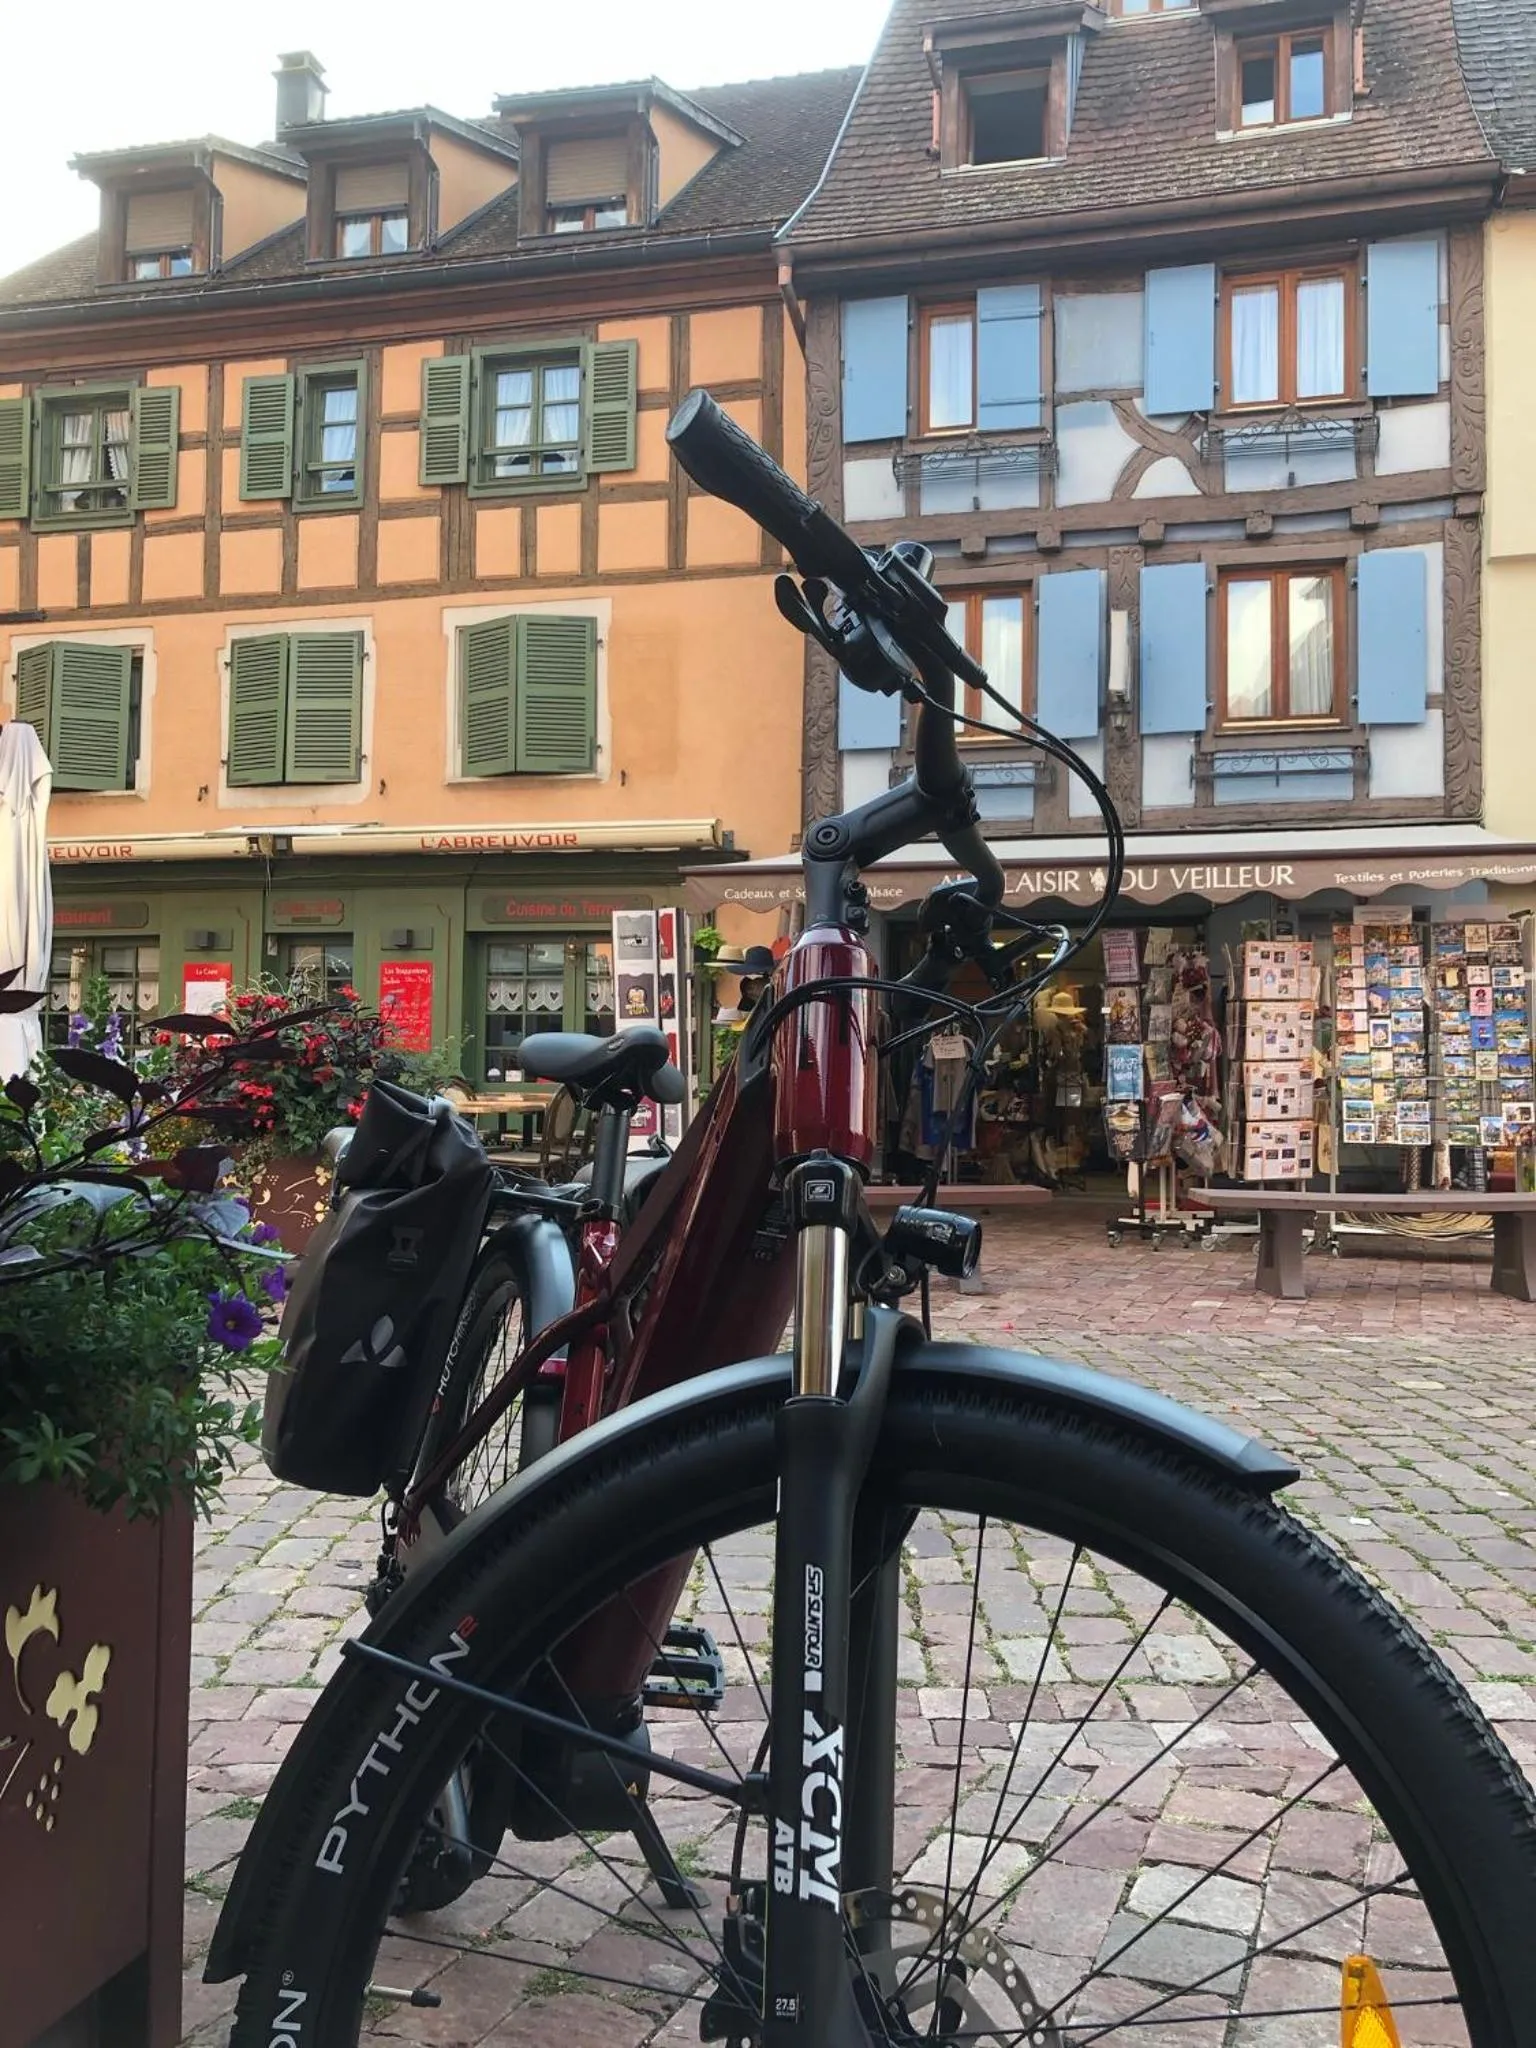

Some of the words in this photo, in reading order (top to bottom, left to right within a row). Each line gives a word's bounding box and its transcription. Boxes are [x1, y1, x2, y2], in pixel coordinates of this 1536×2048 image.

[420, 833, 578, 849] L'ABREUVOIR
[49, 846, 133, 859] EUVOIR
[1004, 870, 1081, 894] LAISIR
[1170, 865, 1295, 890] VEILLEUR
[1333, 872, 1385, 884] Textiles
[1389, 873, 1403, 882] et
[1408, 868, 1464, 880] Poteries
[724, 887, 774, 899] Cadeaux
[779, 888, 791, 898] et
[800, 1709, 843, 1914] XCM
[774, 1816, 795, 1894] ATB
